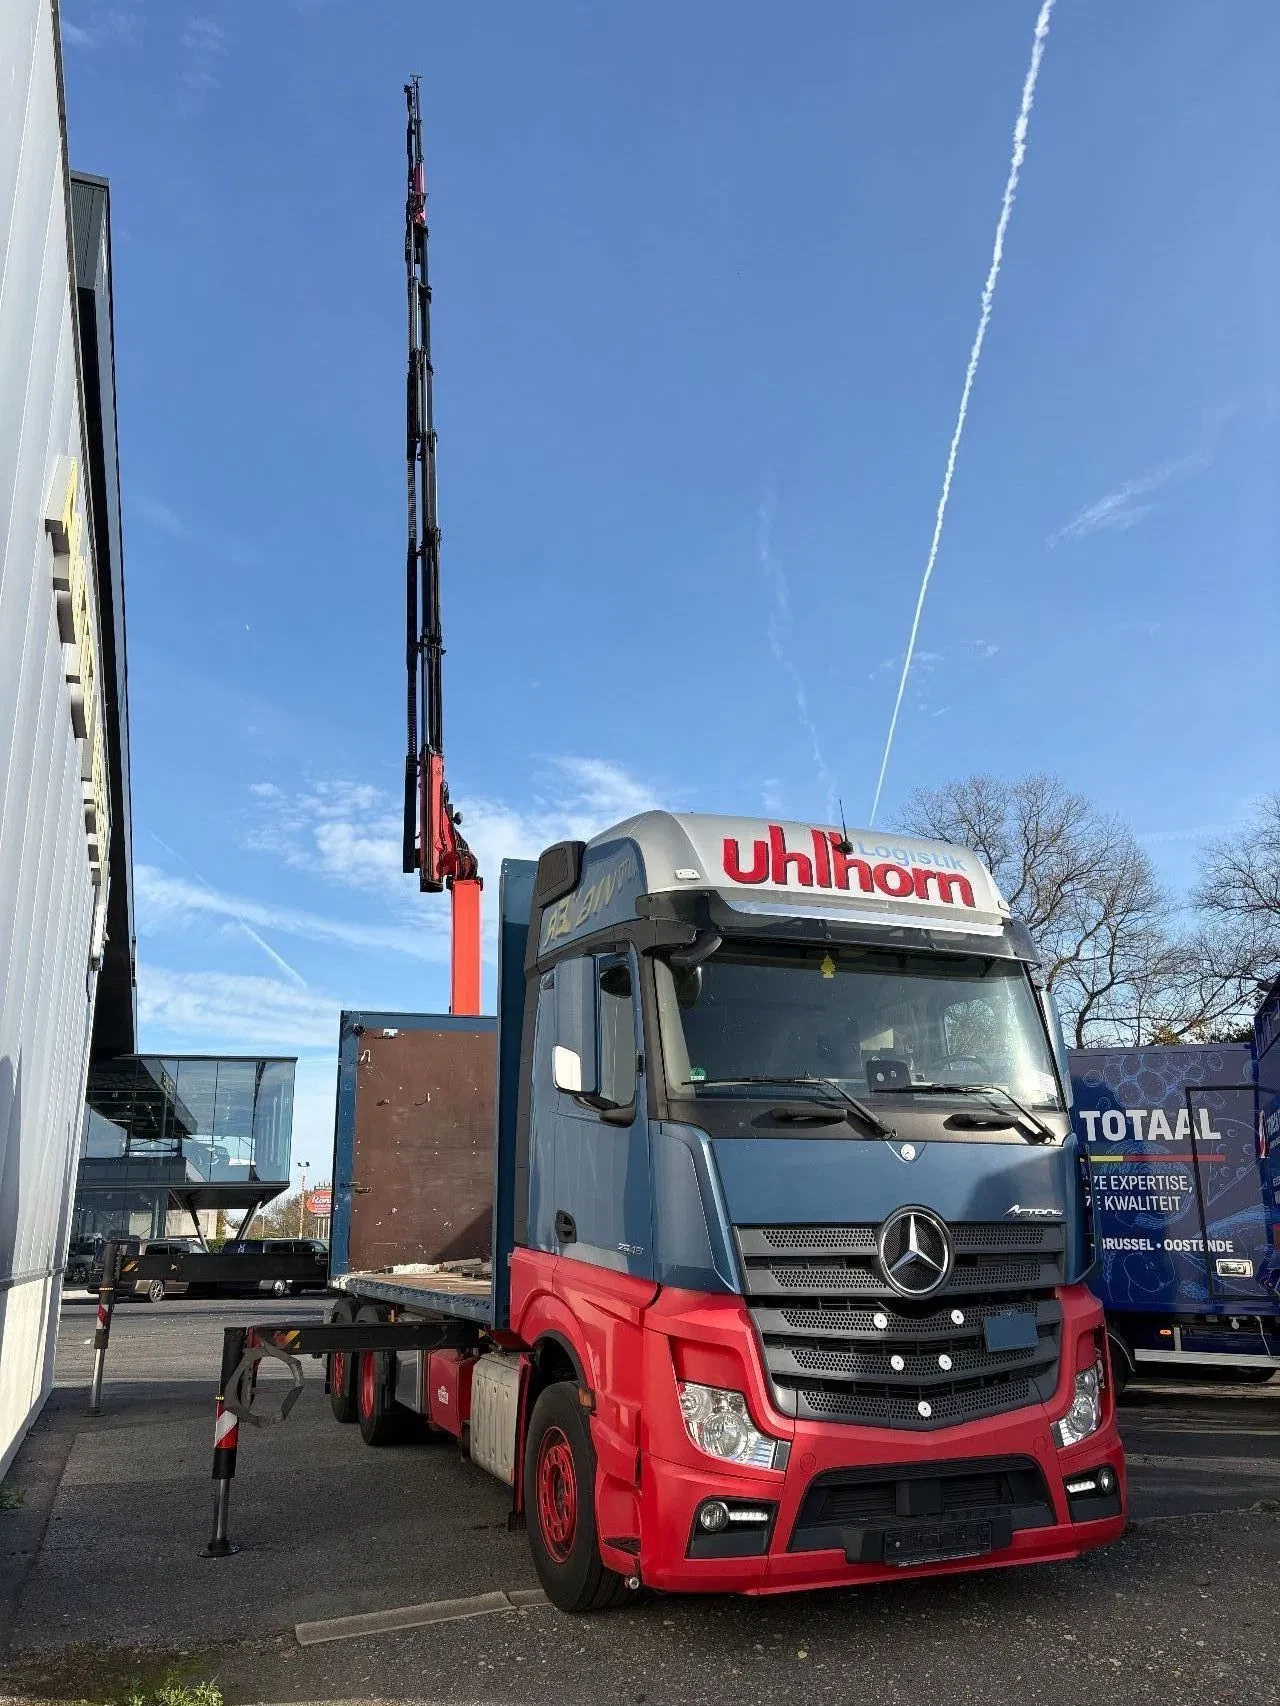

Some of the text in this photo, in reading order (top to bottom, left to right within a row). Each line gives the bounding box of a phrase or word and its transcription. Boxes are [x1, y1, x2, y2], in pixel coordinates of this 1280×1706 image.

[723, 824, 977, 909] uhlhorn
[858, 840, 967, 872] Logistik
[1079, 1108, 1222, 1142] TOTAAL
[1110, 1175, 1193, 1193] EXPERTISE,
[1104, 1195, 1182, 1211] KWALITEIT
[1163, 1239, 1234, 1253] OOSTENDE
